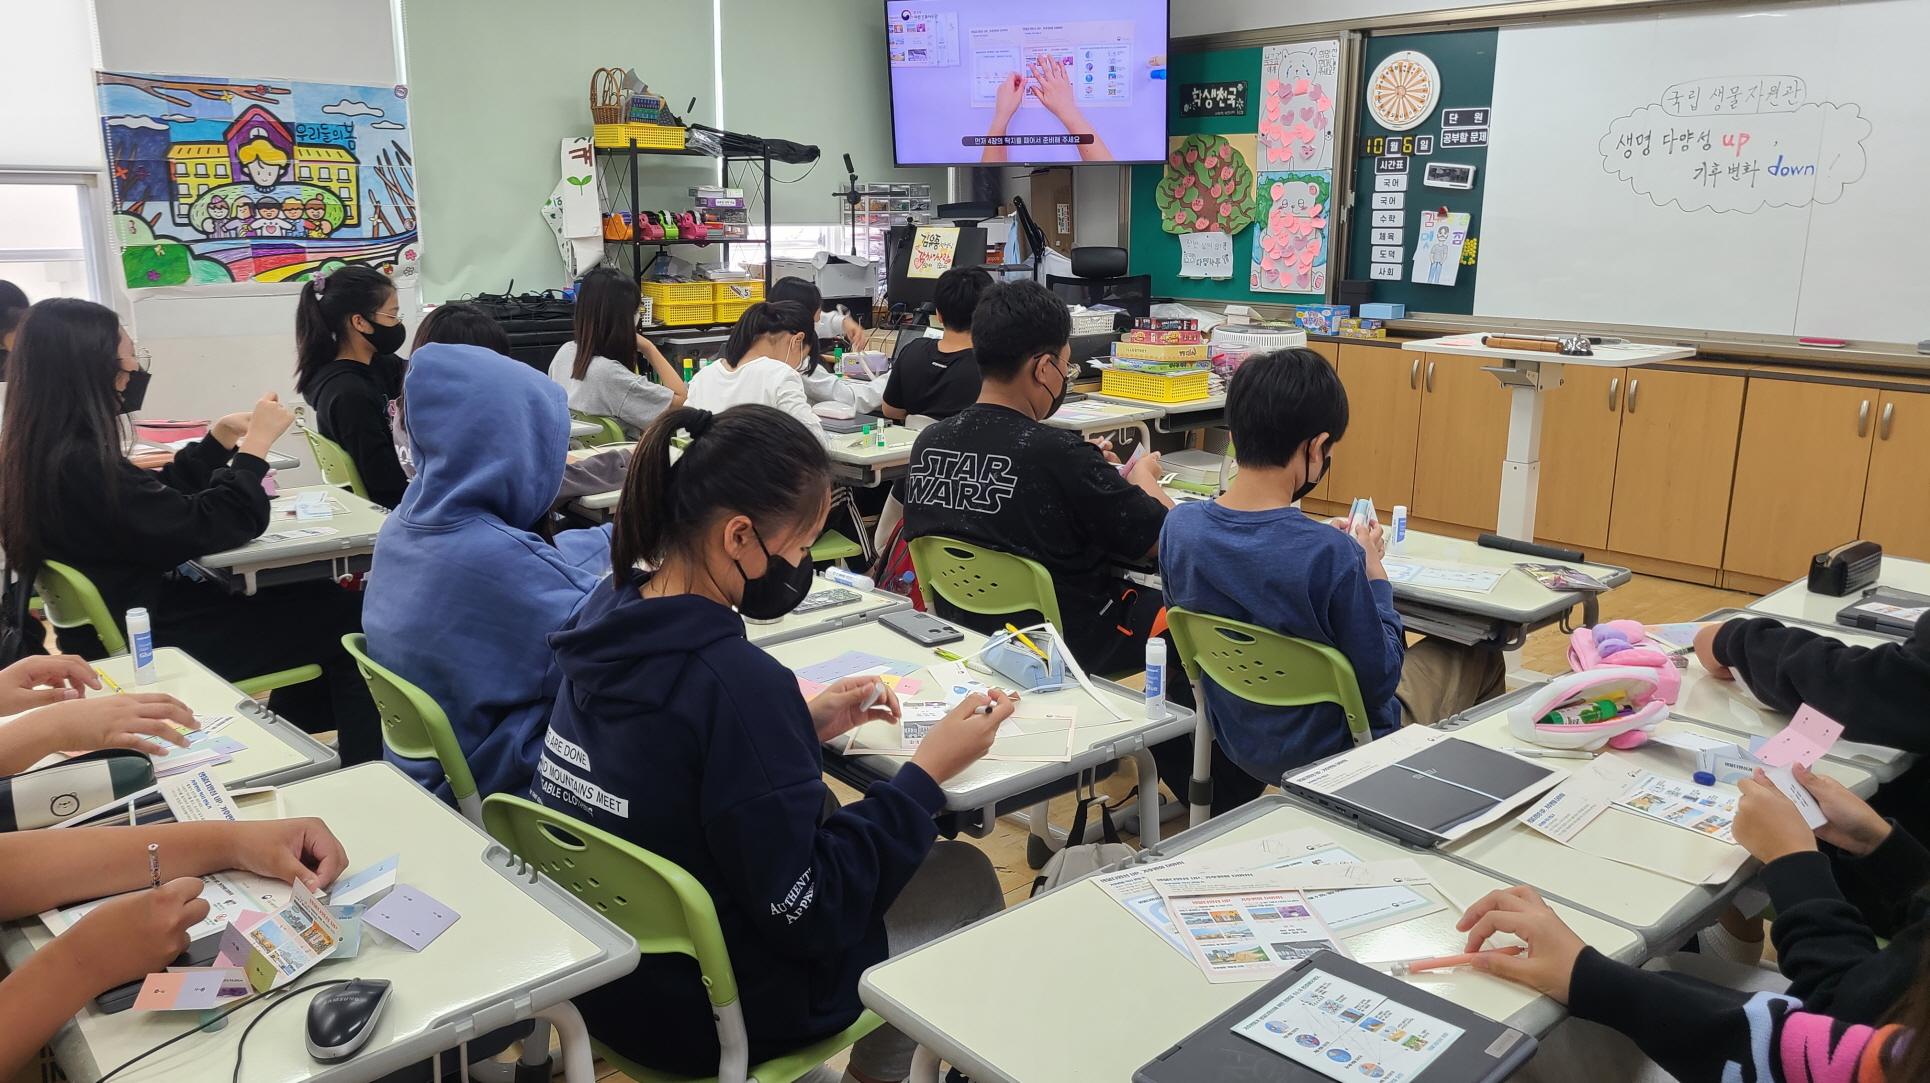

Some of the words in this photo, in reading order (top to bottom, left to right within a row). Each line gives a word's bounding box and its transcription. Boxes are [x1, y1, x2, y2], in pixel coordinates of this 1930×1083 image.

[1192, 87, 1237, 109] 학생천국
[1667, 87, 1701, 113] 국립
[987, 137, 1003, 145] 4장의
[1043, 136, 1060, 144] 준비해
[1062, 135, 1080, 143] 주세요
[1366, 137, 1383, 154] 10
[1389, 141, 1399, 152] 월
[1402, 137, 1412, 153] 6
[1420, 139, 1429, 151] 일
[1443, 132, 1469, 143] 공부할
[1470, 131, 1487, 142] 문제
[1616, 130, 1652, 159] 생명
[1662, 128, 1712, 155] 다양성
[1722, 132, 1751, 157] up
[1380, 160, 1404, 170] 시간표
[1693, 162, 1722, 188] 기후
[1727, 160, 1760, 188] 변화
[1767, 154, 1815, 178] down
[1383, 178, 1399, 188] 국어
[1379, 196, 1396, 206] 국어
[1379, 213, 1396, 224] 수학
[1379, 231, 1395, 242] 체육
[1379, 249, 1396, 259] 도덕
[1378, 267, 1394, 277] 사회
[910, 448, 1018, 488] STAR
[907, 475, 1014, 514] WARS
[550, 735, 563, 753] ARE
[564, 744, 587, 766] DONE
[549, 765, 594, 800] MOUNTAINS
[596, 790, 621, 812] MEET
[771, 867, 811, 916] AUTHENT
